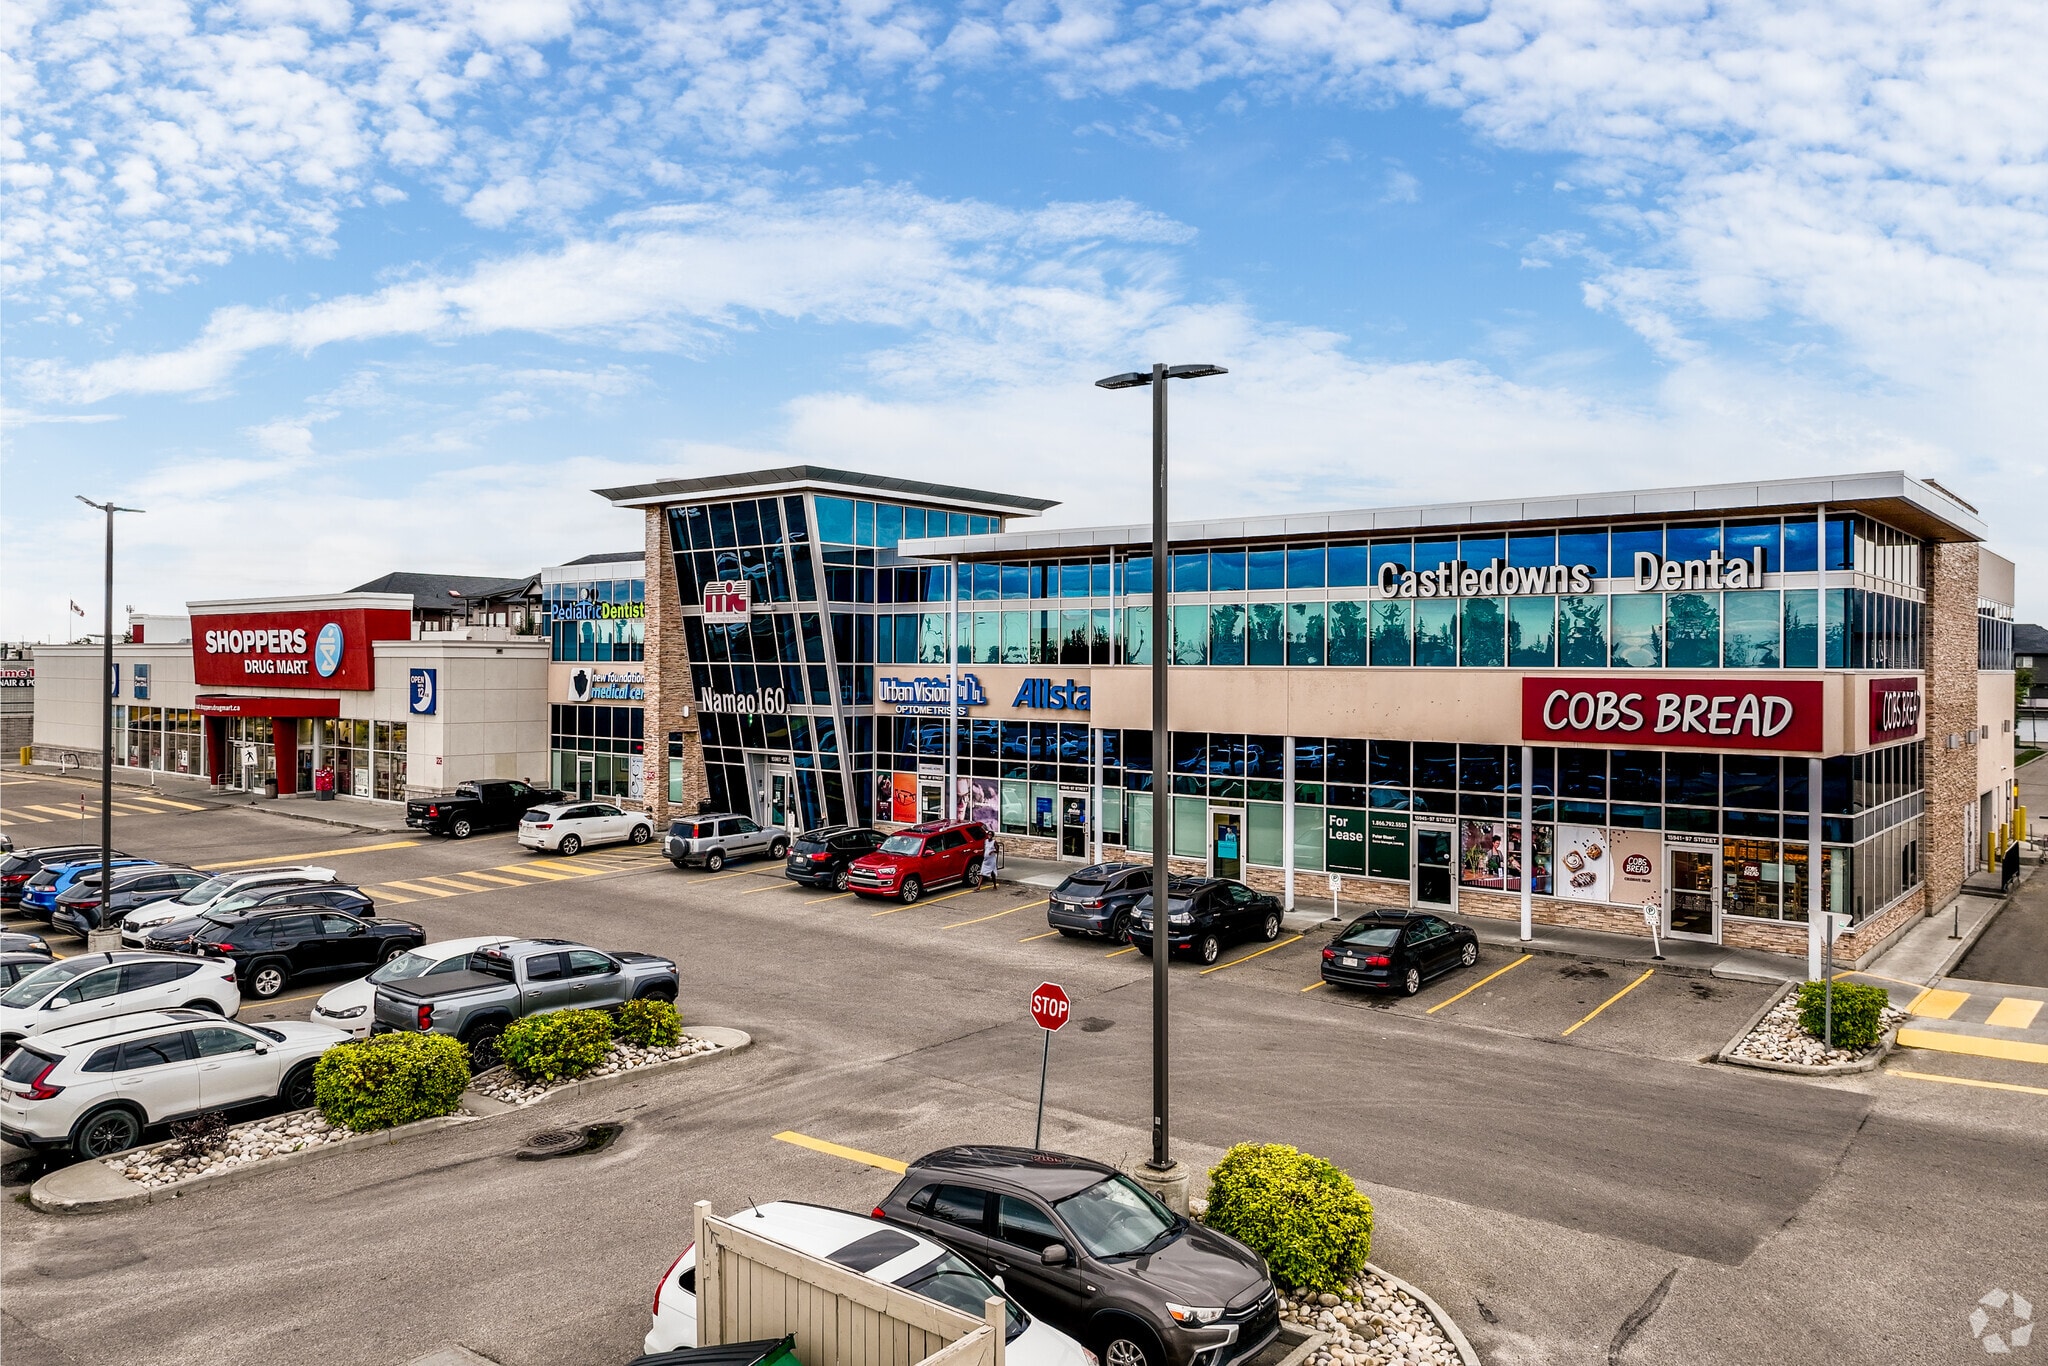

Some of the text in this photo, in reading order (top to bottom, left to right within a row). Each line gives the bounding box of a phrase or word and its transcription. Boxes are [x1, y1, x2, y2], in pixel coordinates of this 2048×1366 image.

[1378, 546, 1763, 598] Castledowns Dental
[205, 628, 307, 654] SHOPPERS
[244, 659, 308, 674] DRUG MART
[19, 679, 25, 687] &
[411, 675, 424, 684] OPEN
[418, 687, 425, 698] 12
[592, 683, 628, 699] medical
[701, 686, 785, 714] Namao 160
[895, 705, 966, 716] OPTOMETRISS
[1543, 689, 1793, 737] COBS BREAD
[1329, 815, 1348, 827] For
[1329, 828, 1363, 841] Lease
[1693, 836, 1718, 844] STREET
[1628, 857, 1648, 866] COBS
[1626, 864, 1650, 873] BREAD
[1033, 995, 1068, 1018] STOP
